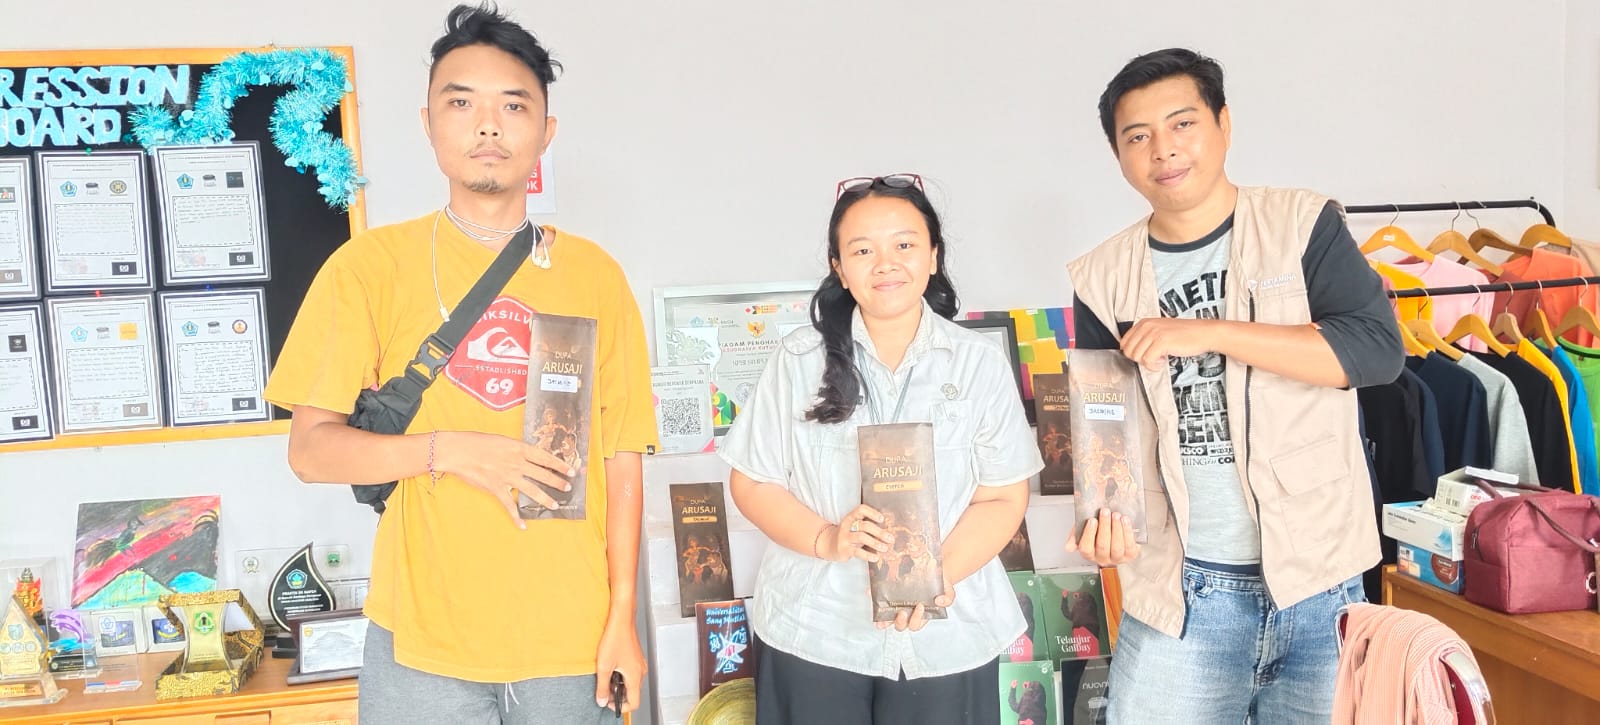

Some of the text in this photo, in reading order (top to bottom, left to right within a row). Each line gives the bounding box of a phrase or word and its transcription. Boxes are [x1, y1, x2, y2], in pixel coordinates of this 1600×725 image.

[542, 361, 583, 375] ARUSAJI
[485, 377, 514, 395] 69
[1083, 392, 1126, 403] ARUSAJI
[873, 464, 922, 479] ARUSAJI
[682, 506, 716, 514] ARUSAJI
